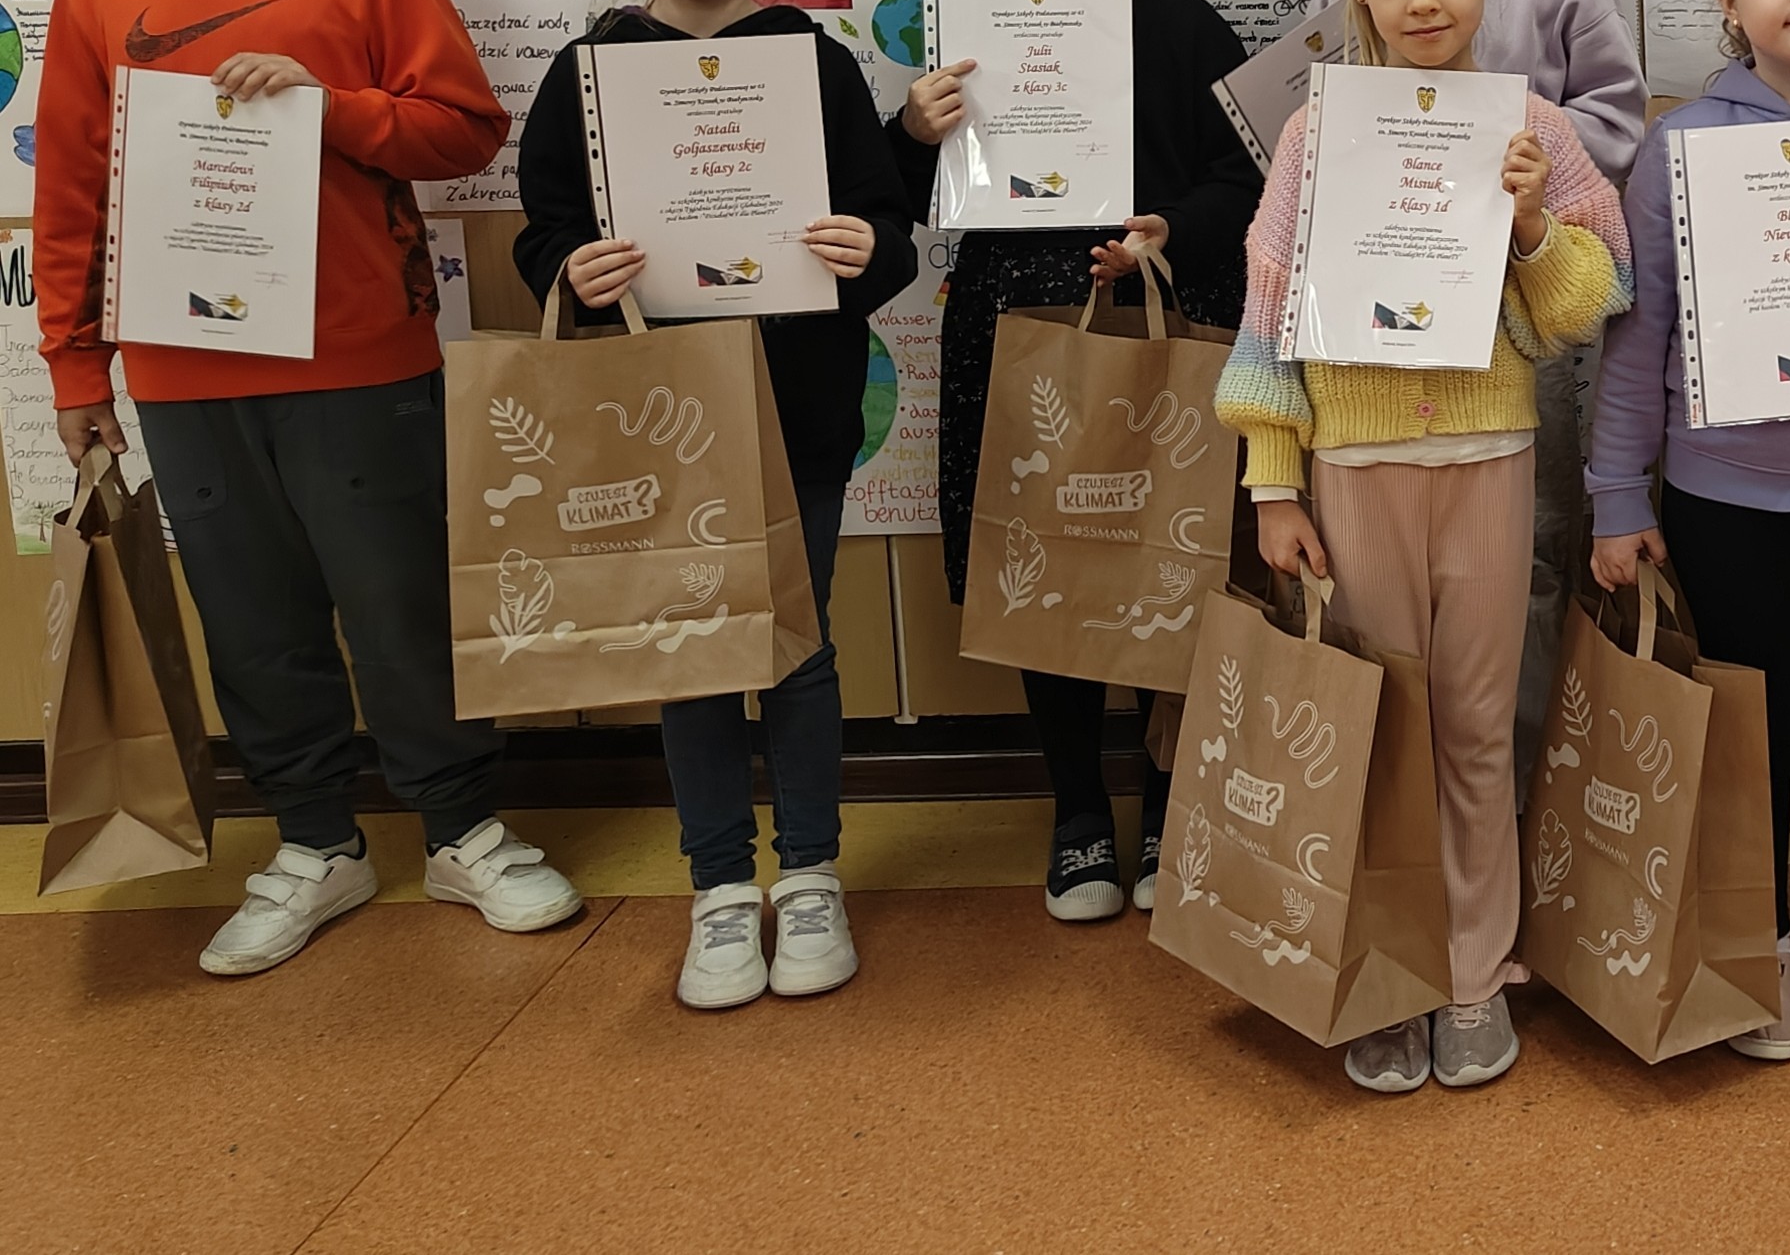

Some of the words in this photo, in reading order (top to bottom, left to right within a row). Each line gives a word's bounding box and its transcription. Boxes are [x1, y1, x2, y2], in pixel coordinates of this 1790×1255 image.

[1026, 45, 1052, 58] Julii
[1018, 61, 1063, 74] Stasiak
[1023, 81, 1052, 95] klasy
[1055, 81, 1068, 92] 3c
[694, 122, 741, 136] Natalii
[193, 159, 255, 176] Marcelowi
[702, 164, 734, 177] klasy
[738, 161, 753, 173] 2c
[1401, 158, 1443, 172] Blance
[204, 198, 234, 214] klasy
[237, 201, 254, 213] 2d
[1400, 198, 1430, 214] klasy
[1434, 200, 1452, 213] 1d
[875, 306, 936, 326] Wasser
[1076, 477, 1124, 489] CZUJESZ
